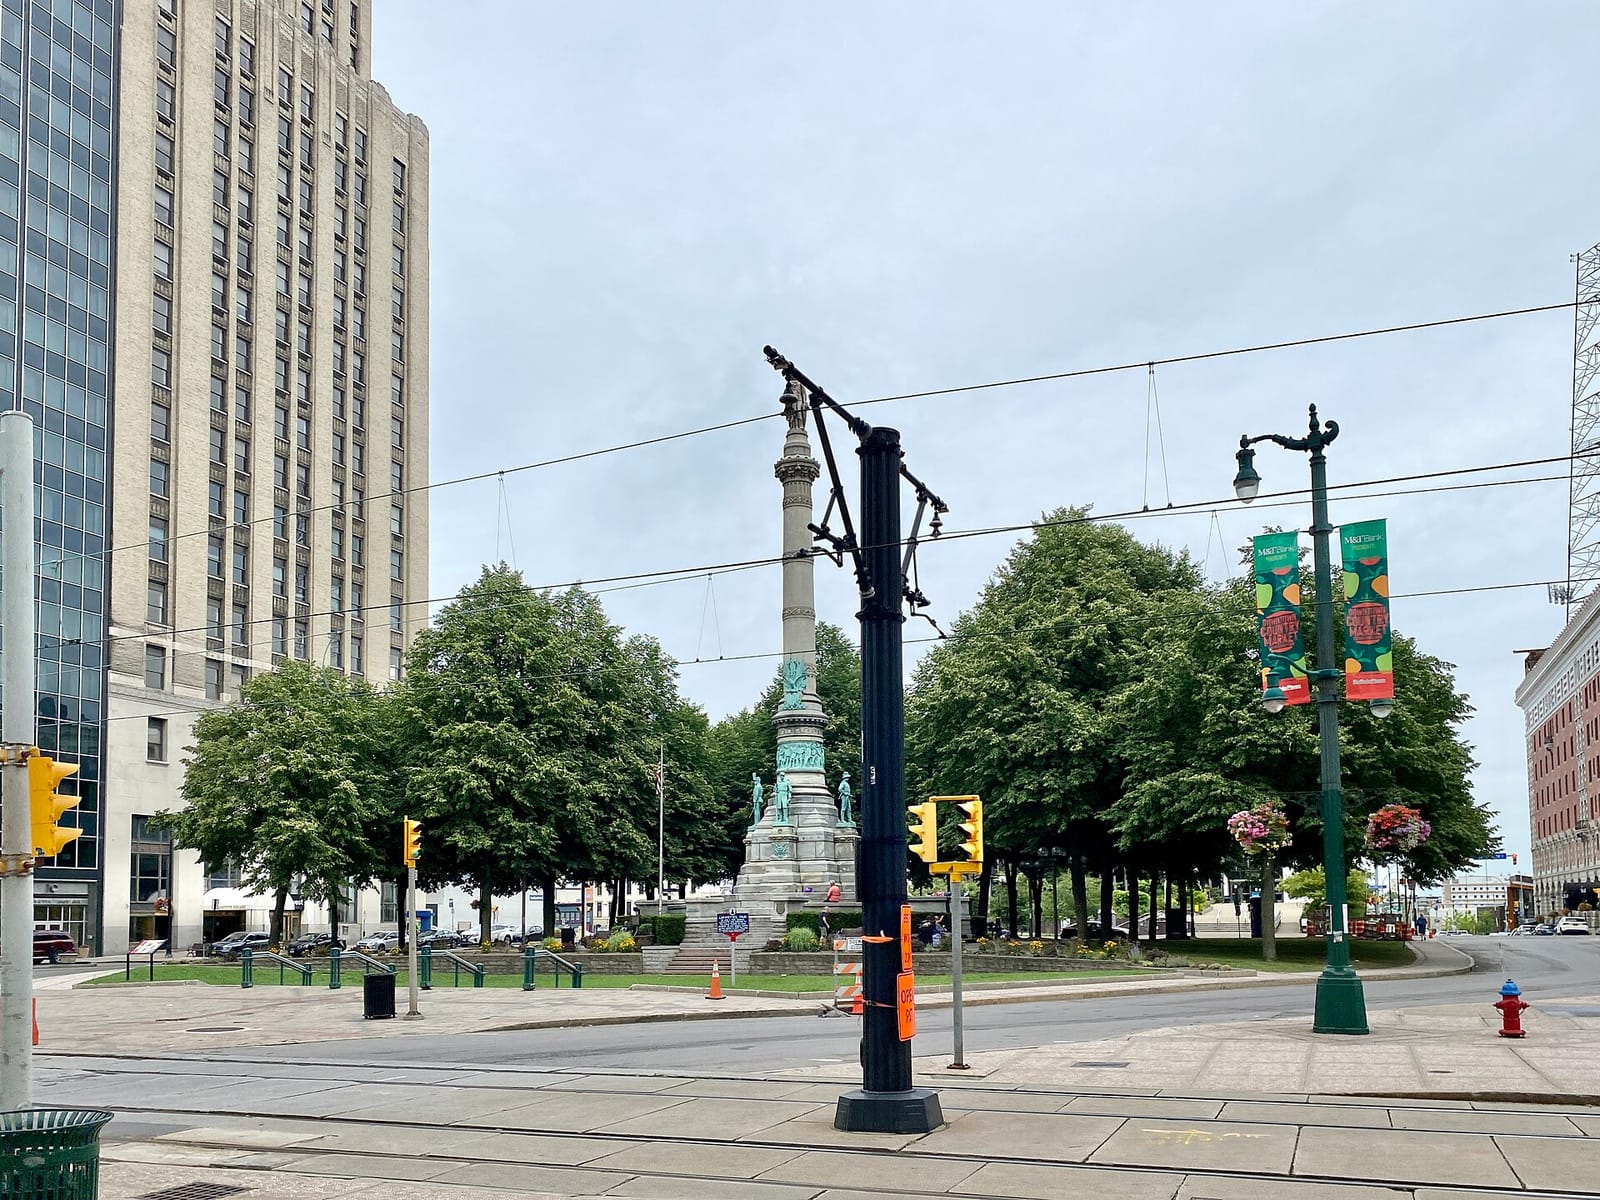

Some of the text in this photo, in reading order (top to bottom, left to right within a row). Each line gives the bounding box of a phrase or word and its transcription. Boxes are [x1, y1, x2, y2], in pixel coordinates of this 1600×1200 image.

[1344, 533, 1384, 544] M&T Bank
[1258, 544, 1297, 556] M&T Bank
[1350, 624, 1386, 637] MARKET
[1264, 631, 1297, 647] MARKET
[901, 988, 913, 1004] OPE
